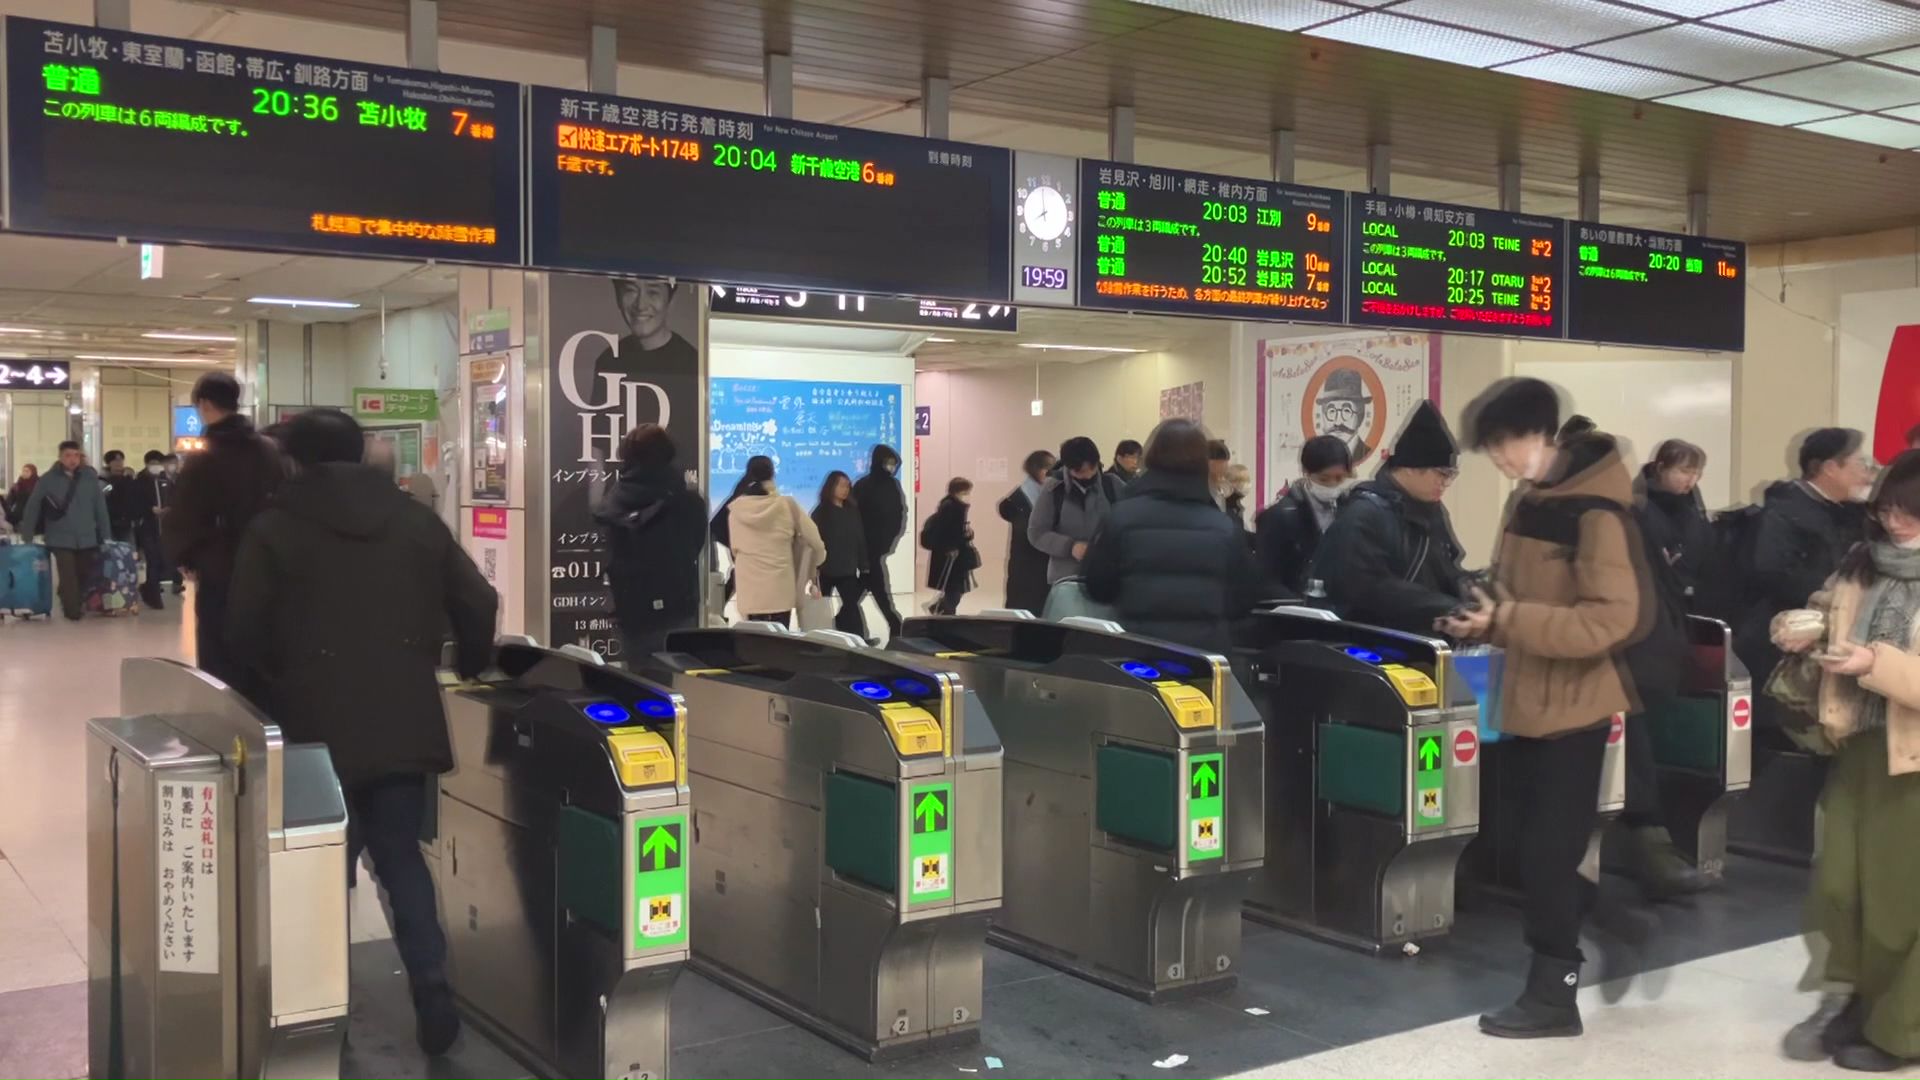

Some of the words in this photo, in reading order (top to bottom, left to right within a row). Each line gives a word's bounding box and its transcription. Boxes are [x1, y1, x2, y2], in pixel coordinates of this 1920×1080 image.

[42, 64, 100, 95] 普通
[253, 88, 339, 121] 20:36
[356, 101, 428, 132] 苫小牧
[560, 97, 754, 142] 新千歳空港行発着時刻
[775, 125, 789, 134] New
[816, 131, 838, 141] Airport
[578, 128, 701, 162] 快速エアポート174号
[713, 143, 777, 173] 20:04
[790, 152, 861, 183] 新千歳空港
[1017, 187, 1028, 199] 10
[1097, 190, 1126, 211] 普通
[1017, 205, 1024, 217] 9
[1202, 201, 1248, 224] 20:03
[1256, 207, 1282, 228] 江別
[1362, 221, 1399, 238] LOCAL
[1097, 234, 1126, 255] 普通
[1448, 229, 1486, 250] 20:03
[1492, 236, 1521, 252] TEINE
[1543, 240, 1552, 257] 2
[1096, 256, 1126, 277] 普通
[1202, 243, 1248, 266] 20:40
[1256, 249, 1294, 269] 岩見沢
[1649, 252, 1680, 271] 20:20
[1023, 266, 1066, 289] 19:59
[1201, 264, 1247, 286] 20:52
[1256, 269, 1294, 290] 岩見沢
[1361, 260, 1399, 277] LOCAL
[1447, 267, 1485, 287] 20:17
[1491, 273, 1525, 289] OTARU
[1361, 280, 1398, 297] LOCAL
[1543, 276, 1551, 293] 2
[1447, 286, 1485, 305] 20:25
[1491, 291, 1520, 307] TEINE
[1543, 295, 1551, 311] 3
[922, 412, 930, 429] 2
[575, 620, 587, 631] 13
[162, 785, 175, 852] 割り込みは
[181, 786, 195, 830] 順番に
[200, 786, 214, 875] 有人改札口は
[163, 867, 176, 961] おやめください
[181, 845, 196, 964] ご案内いたします
[955, 1009, 963, 1021] 3
[899, 1020, 906, 1032] 2
